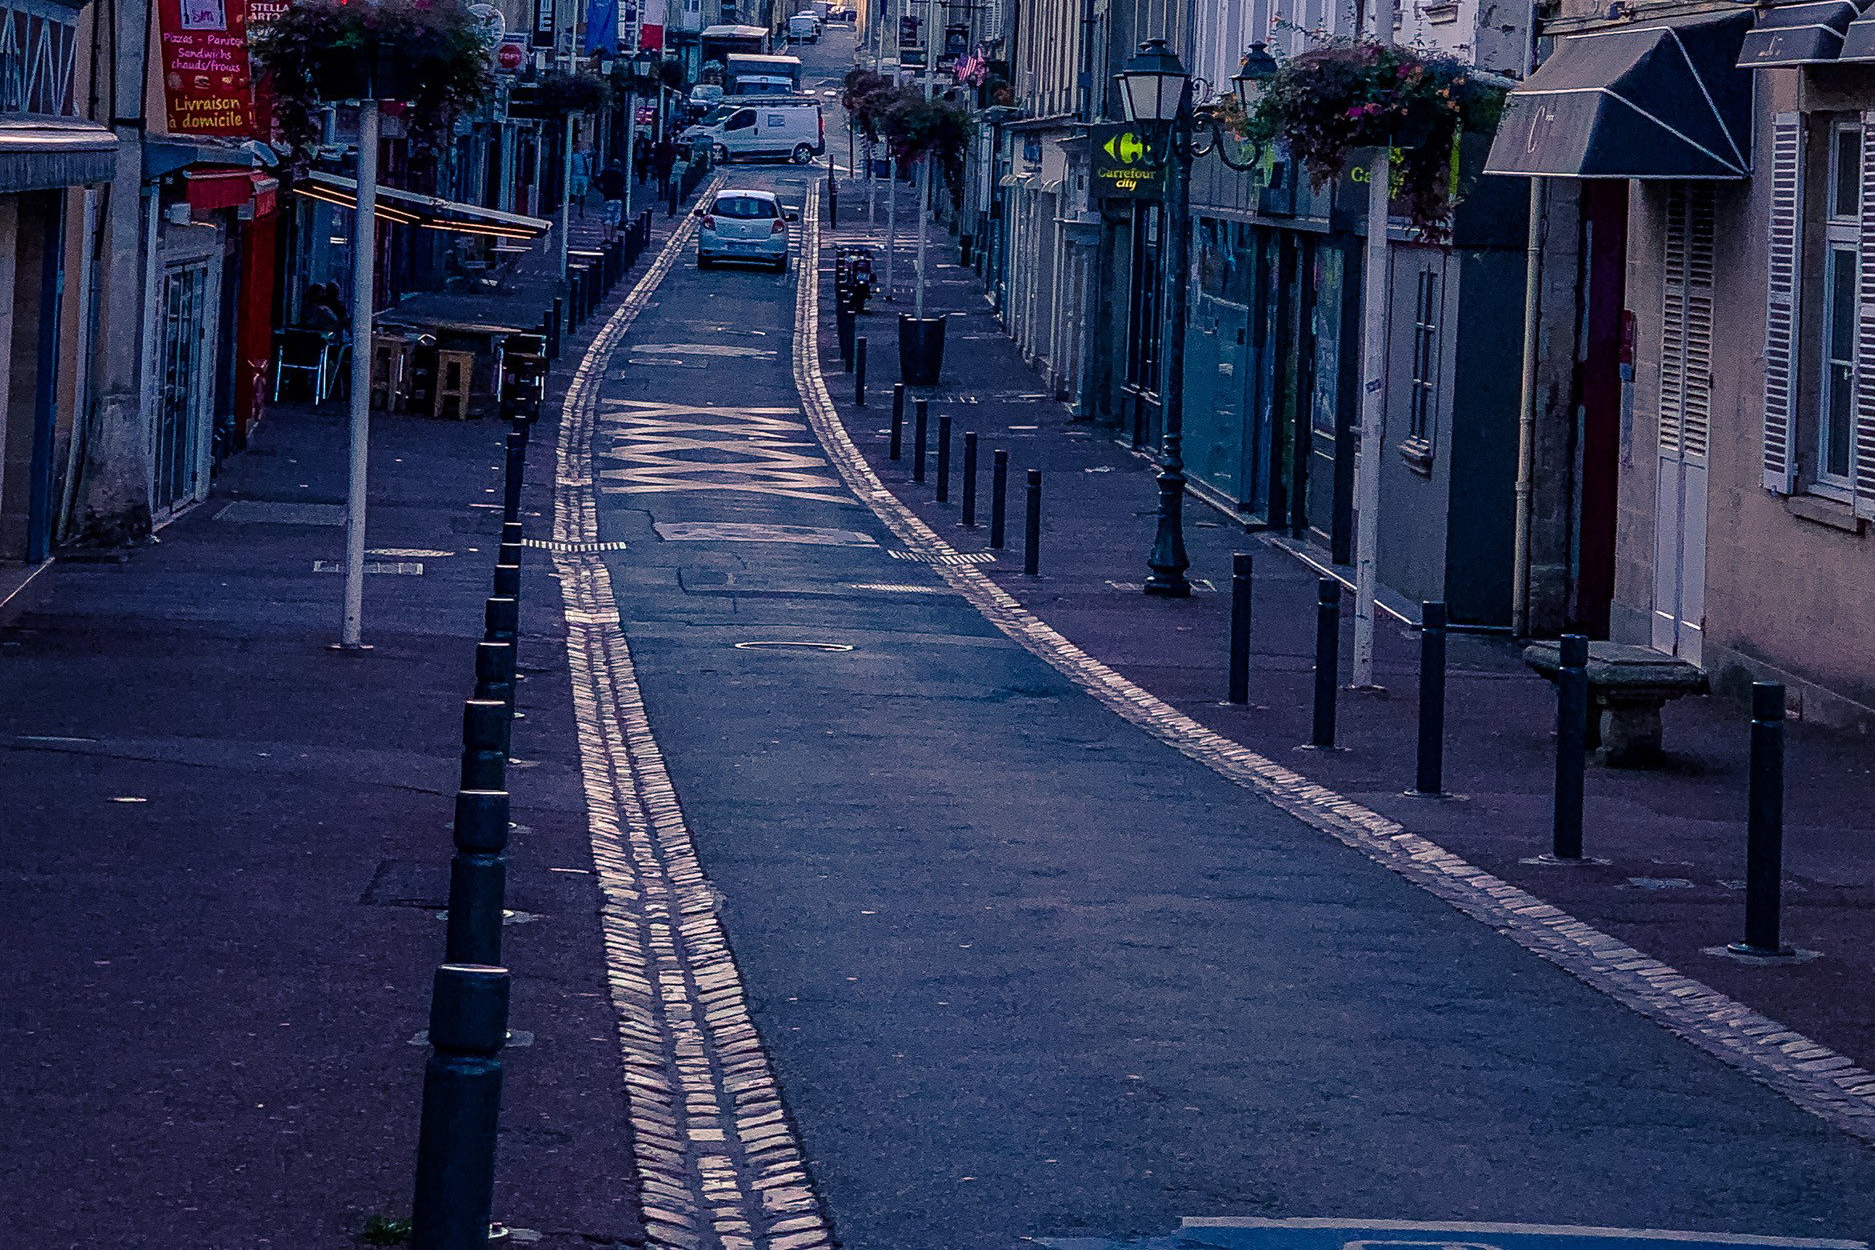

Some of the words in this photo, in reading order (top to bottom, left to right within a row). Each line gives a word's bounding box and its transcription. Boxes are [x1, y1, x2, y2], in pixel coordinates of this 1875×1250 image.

[250, 3, 290, 13] STELLA
[163, 32, 193, 43] Pizzas
[175, 95, 240, 111] Livraison
[168, 114, 177, 128] à
[183, 111, 243, 127] domicile
[1098, 167, 1156, 179] Carrefour
[1116, 179, 1137, 191] city
